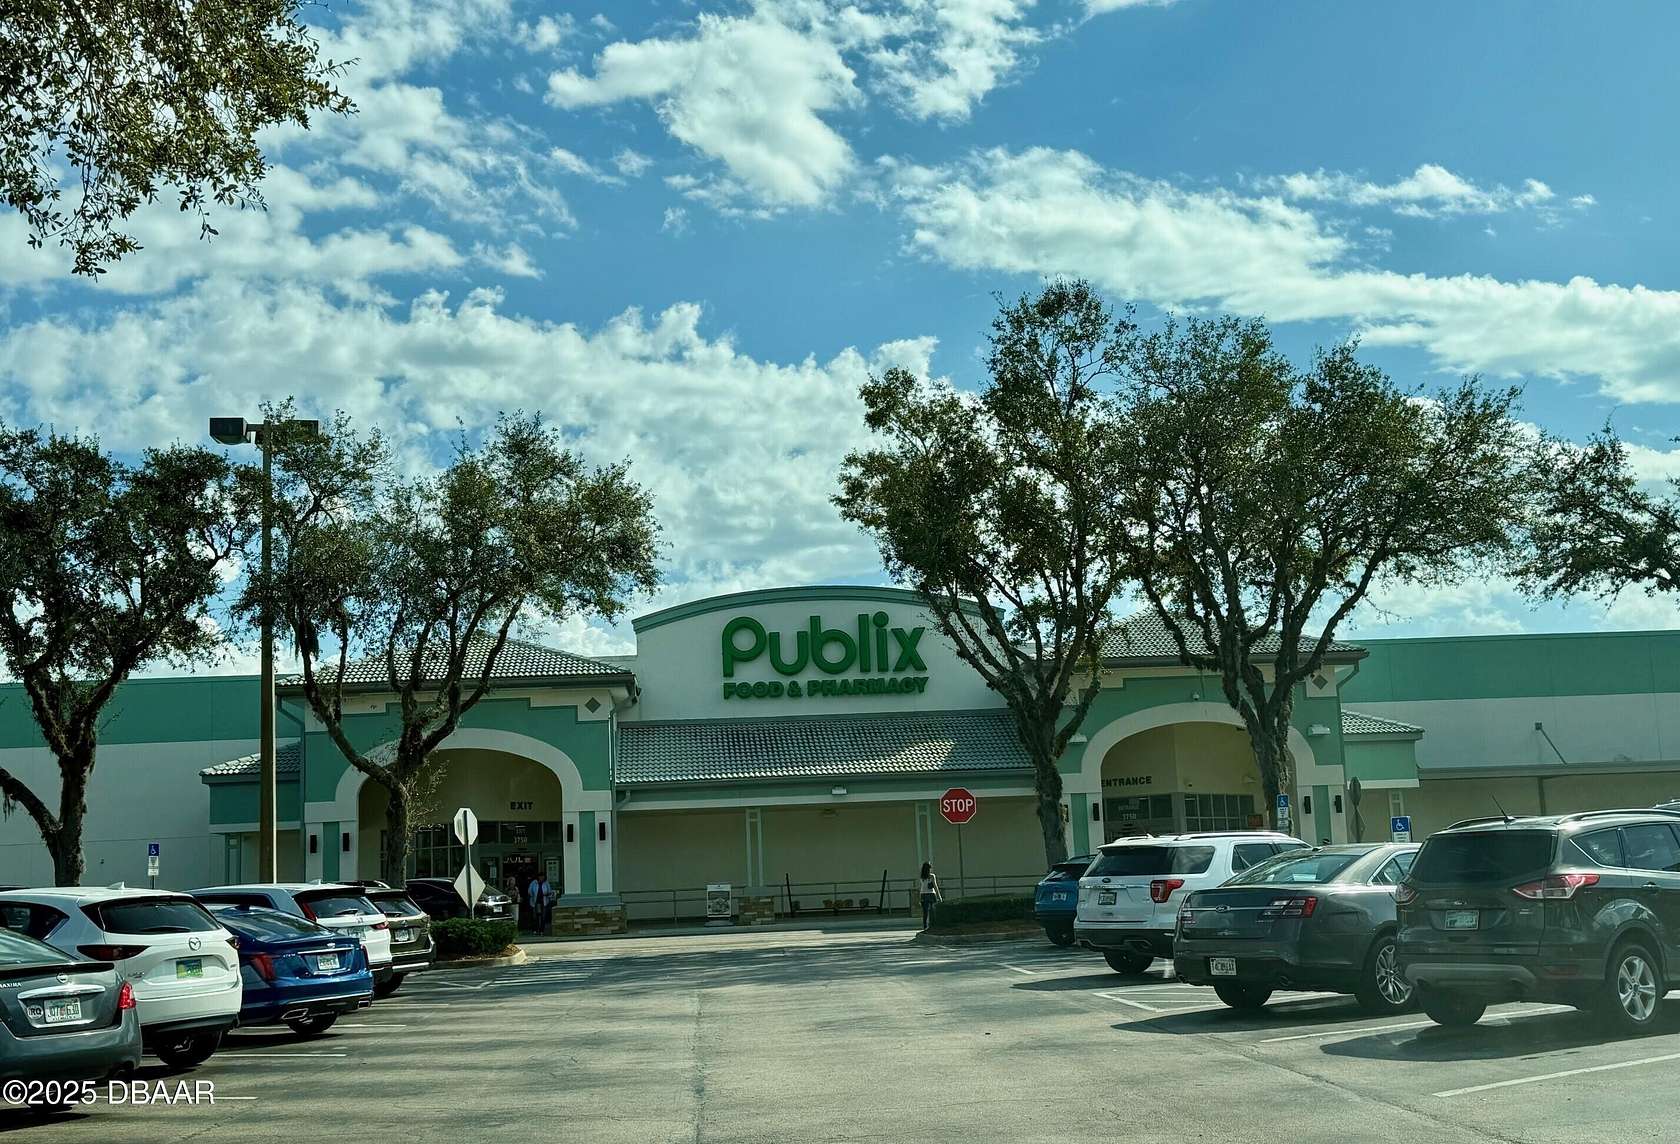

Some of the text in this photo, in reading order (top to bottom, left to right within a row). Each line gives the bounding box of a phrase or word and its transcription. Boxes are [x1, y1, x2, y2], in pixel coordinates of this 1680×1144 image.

[722, 611, 928, 677] Publix
[723, 677, 929, 699] FOOD & PHARMACY
[1101, 776, 1152, 788] ENTRANCE
[510, 801, 534, 810] EXIT
[943, 799, 973, 813] STOP
